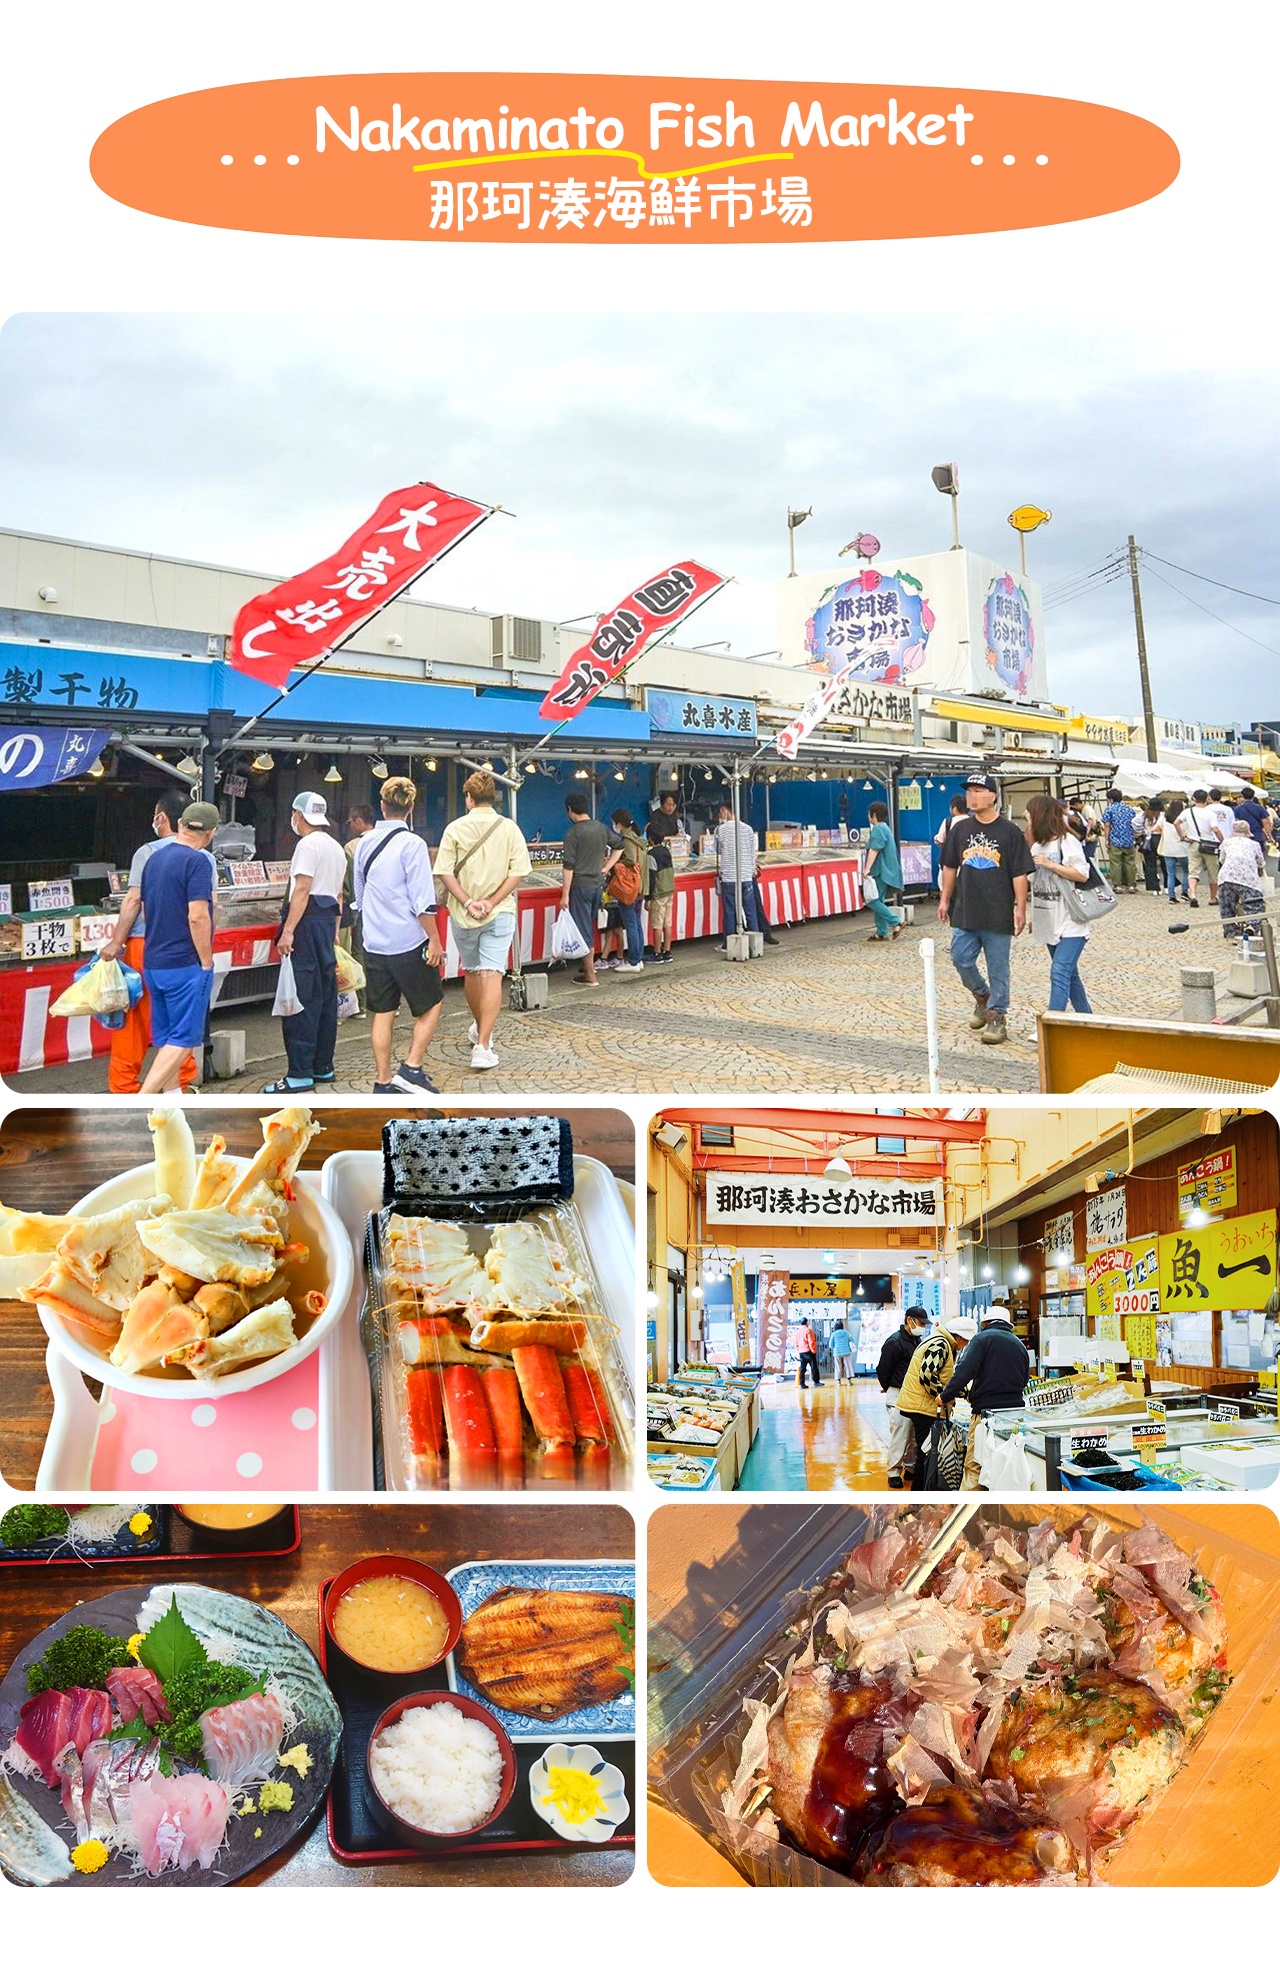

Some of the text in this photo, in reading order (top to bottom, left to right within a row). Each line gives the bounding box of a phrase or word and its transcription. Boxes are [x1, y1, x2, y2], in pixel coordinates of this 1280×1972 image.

[241, 499, 438, 660] 大売出し
[834, 591, 898, 622] 那珂湊
[826, 617, 910, 646] おさかな
[682, 703, 752, 732] 丸喜水産
[0, 734, 44, 778] の
[32, 922, 65, 941] 干物
[26, 940, 70, 956] 3枚で
[716, 1185, 936, 1216] 那珂湊おさかな市場
[1220, 1222, 1275, 1254] うおいち
[1166, 1238, 1271, 1298] 魚一
[1115, 1291, 1160, 1312] 3000円
[1071, 1437, 1107, 1449] 生わかめ
